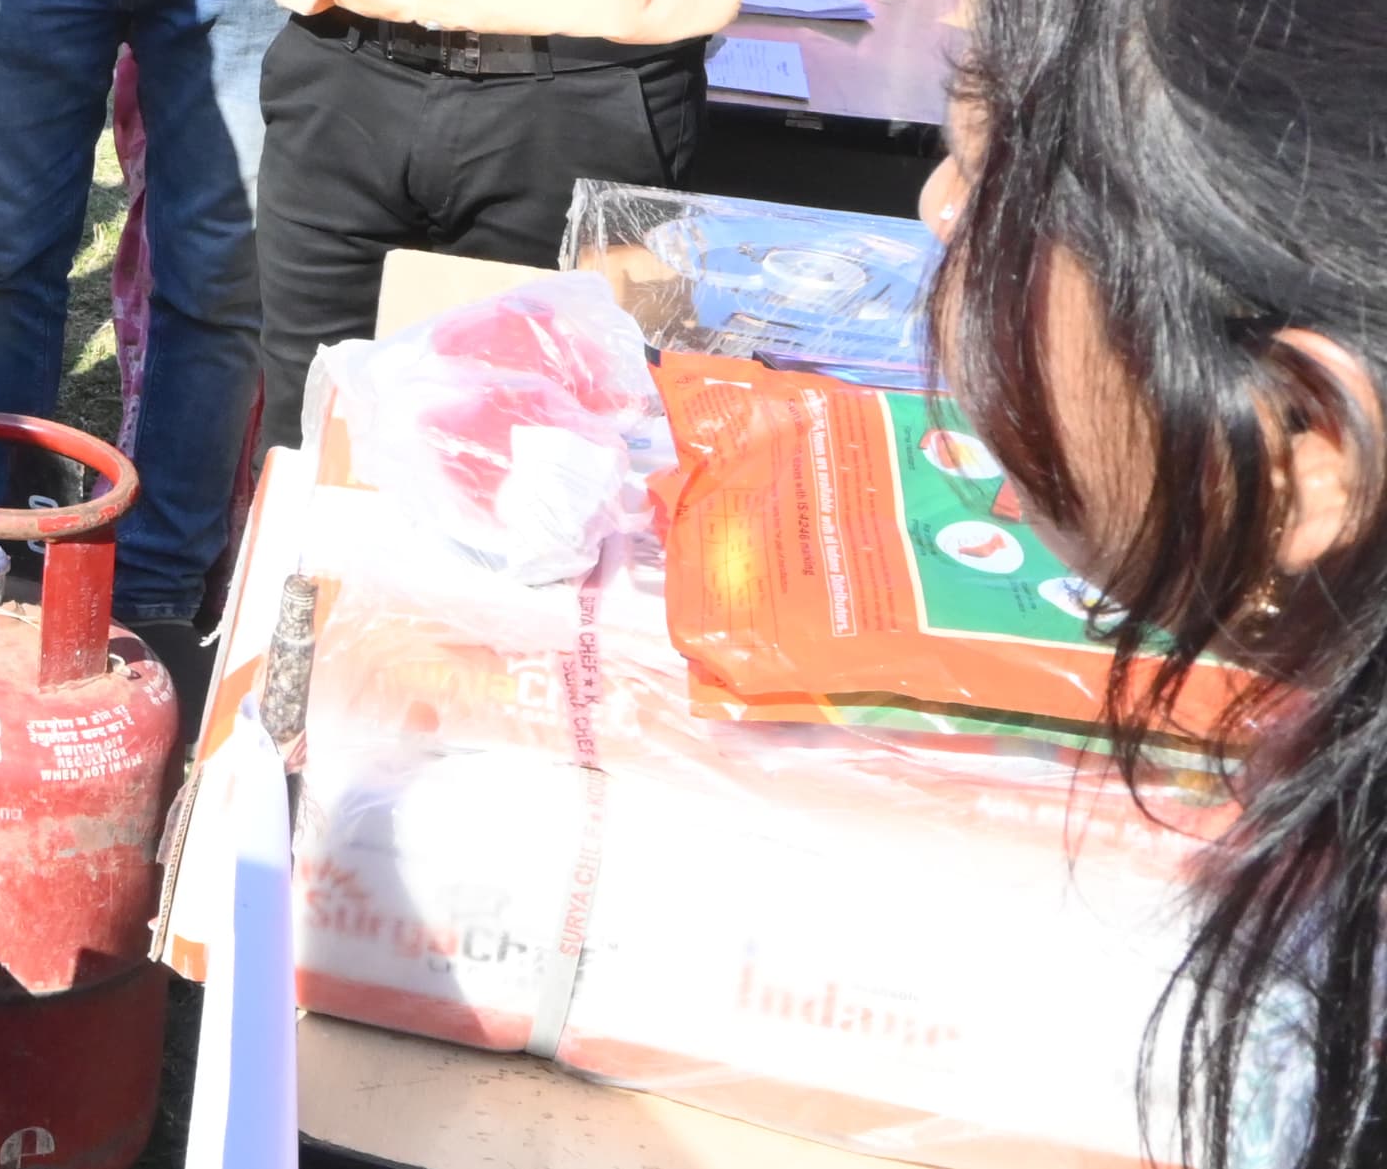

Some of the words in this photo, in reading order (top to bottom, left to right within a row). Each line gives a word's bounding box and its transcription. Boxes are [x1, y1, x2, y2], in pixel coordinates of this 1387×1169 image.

[579, 632, 597, 673] CHEF
[53, 742, 102, 757] SWITCH
[104, 734, 124, 750] OFF
[574, 717, 595, 755] CHEF
[40, 768, 79, 781] WHEN
[82, 764, 107, 779] NOT
[108, 761, 122, 774] IN
[57, 747, 127, 769] REGULATOR
[559, 892, 588, 958] SURYA
